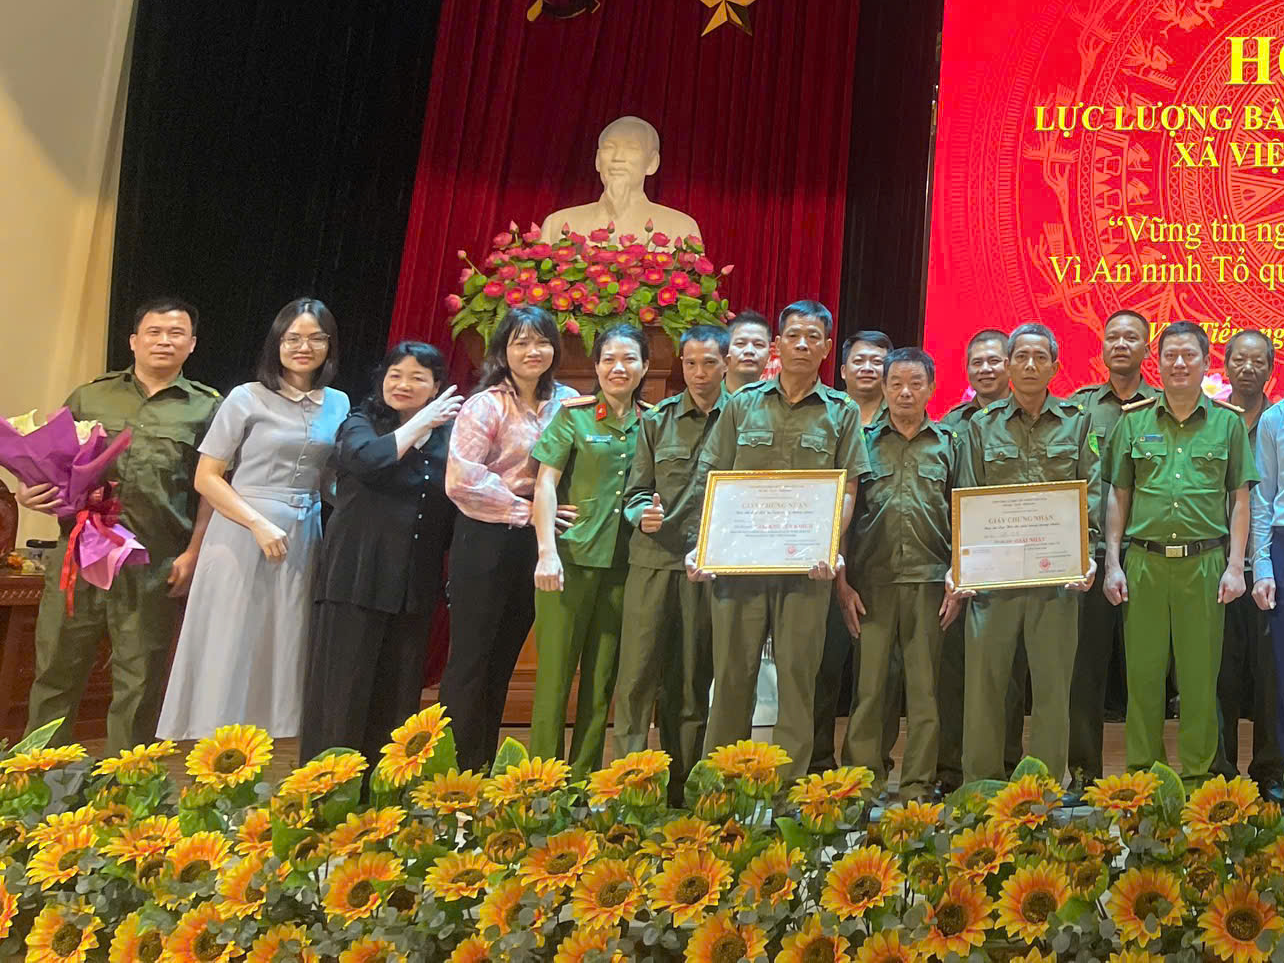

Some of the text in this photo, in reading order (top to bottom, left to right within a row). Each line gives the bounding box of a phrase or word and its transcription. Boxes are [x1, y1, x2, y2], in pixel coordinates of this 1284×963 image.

[1034, 101, 1104, 137] LỰC
[1114, 100, 1233, 137] LƯỢNG
[1173, 138, 1221, 168] XÃ
[1210, 215, 1248, 243] tin
[1049, 255, 1081, 283] Vì
[1088, 255, 1132, 283] An
[1142, 255, 1202, 283] ninh
[1211, 248, 1250, 284] Tổ
